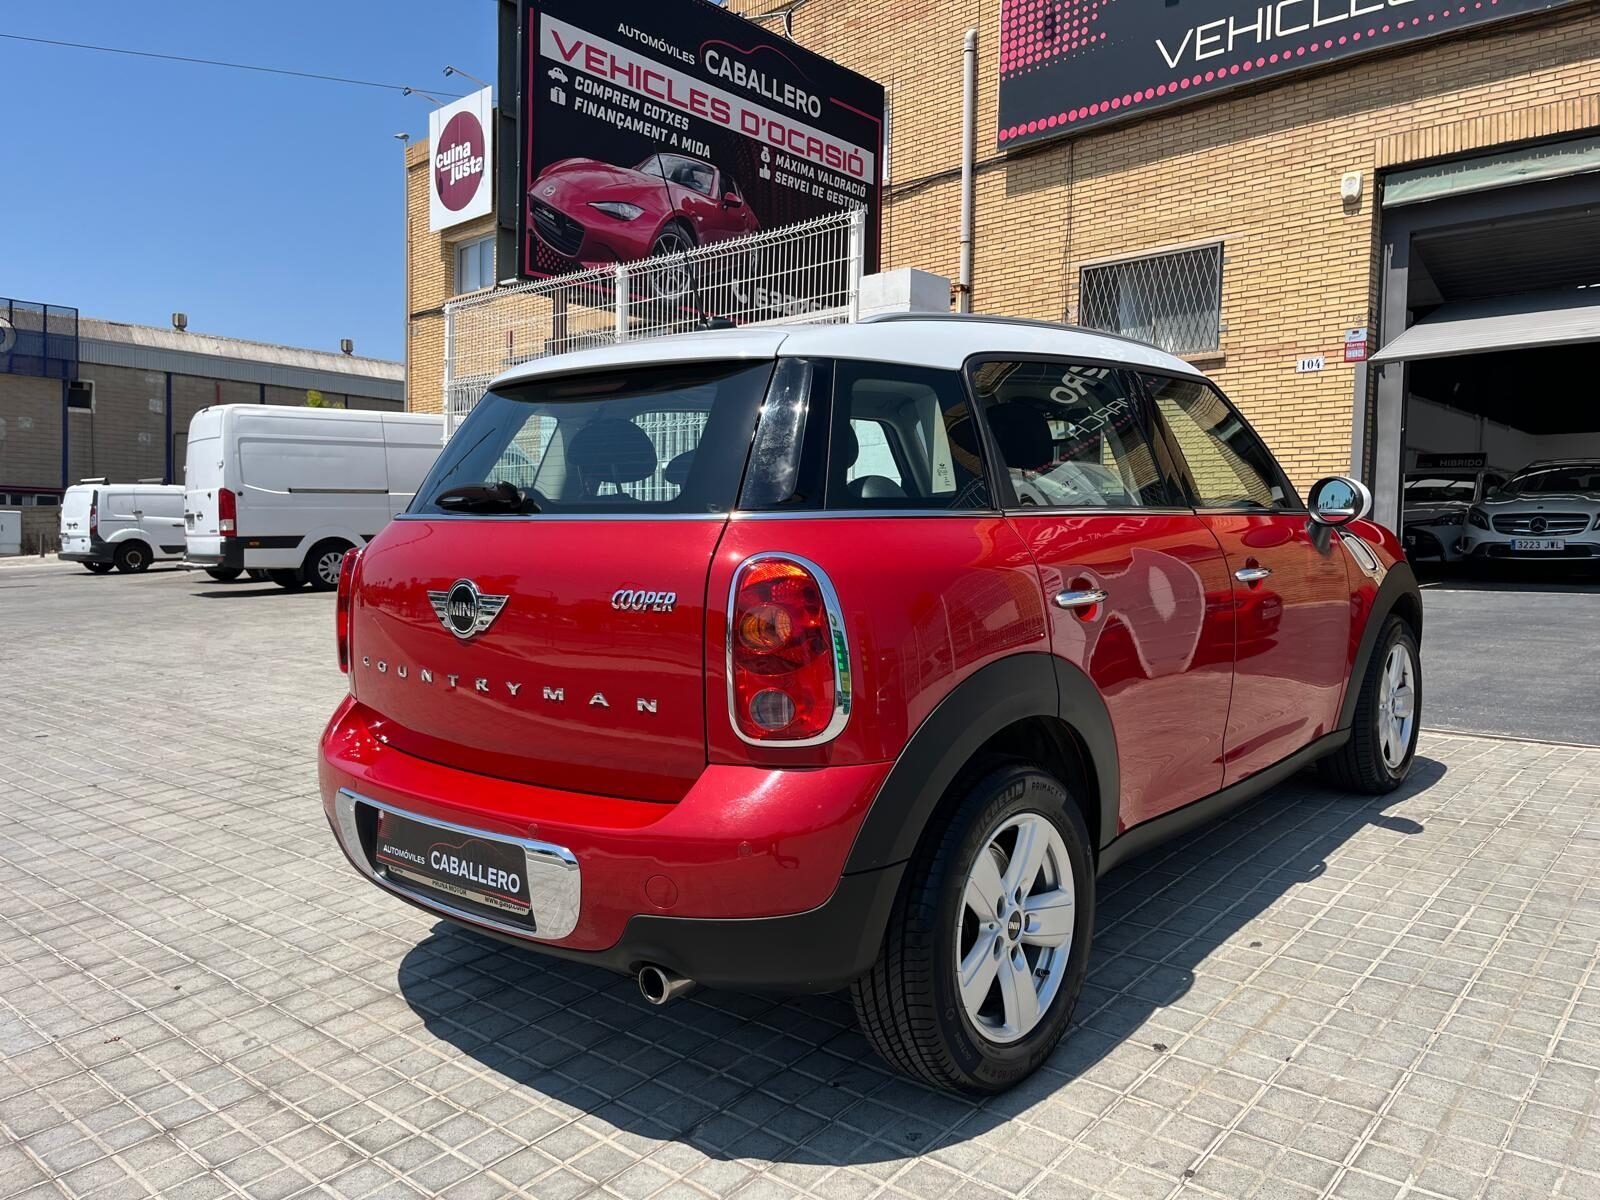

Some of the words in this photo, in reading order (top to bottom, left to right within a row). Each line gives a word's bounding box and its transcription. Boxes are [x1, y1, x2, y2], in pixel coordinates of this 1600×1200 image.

[618, 23, 695, 65] AUTOMÓVILES
[705, 50, 821, 118] CABALLERO
[551, 29, 731, 125] VEHICLES
[741, 109, 863, 178] D'OCASIÓ
[574, 76, 640, 112] COMPREM
[643, 102, 689, 131] COTXES
[574, 97, 668, 142] FINANÇAMENT
[669, 133, 678, 147] A
[681, 136, 711, 158] MIDA
[436, 142, 471, 168] cuina
[450, 156, 483, 186] justa
[775, 154, 815, 179] MÀXIMA
[817, 170, 866, 198] VALORACIÓ
[775, 171, 810, 194] SERVEI
[812, 184, 825, 199] DE
[1301, 358, 1320, 370] 104
[450, 601, 475, 617] MINI
[611, 589, 677, 612] COOPER
[383, 844, 426, 865] AUTOMÓVILES
[430, 850, 521, 893] CABALLERO
